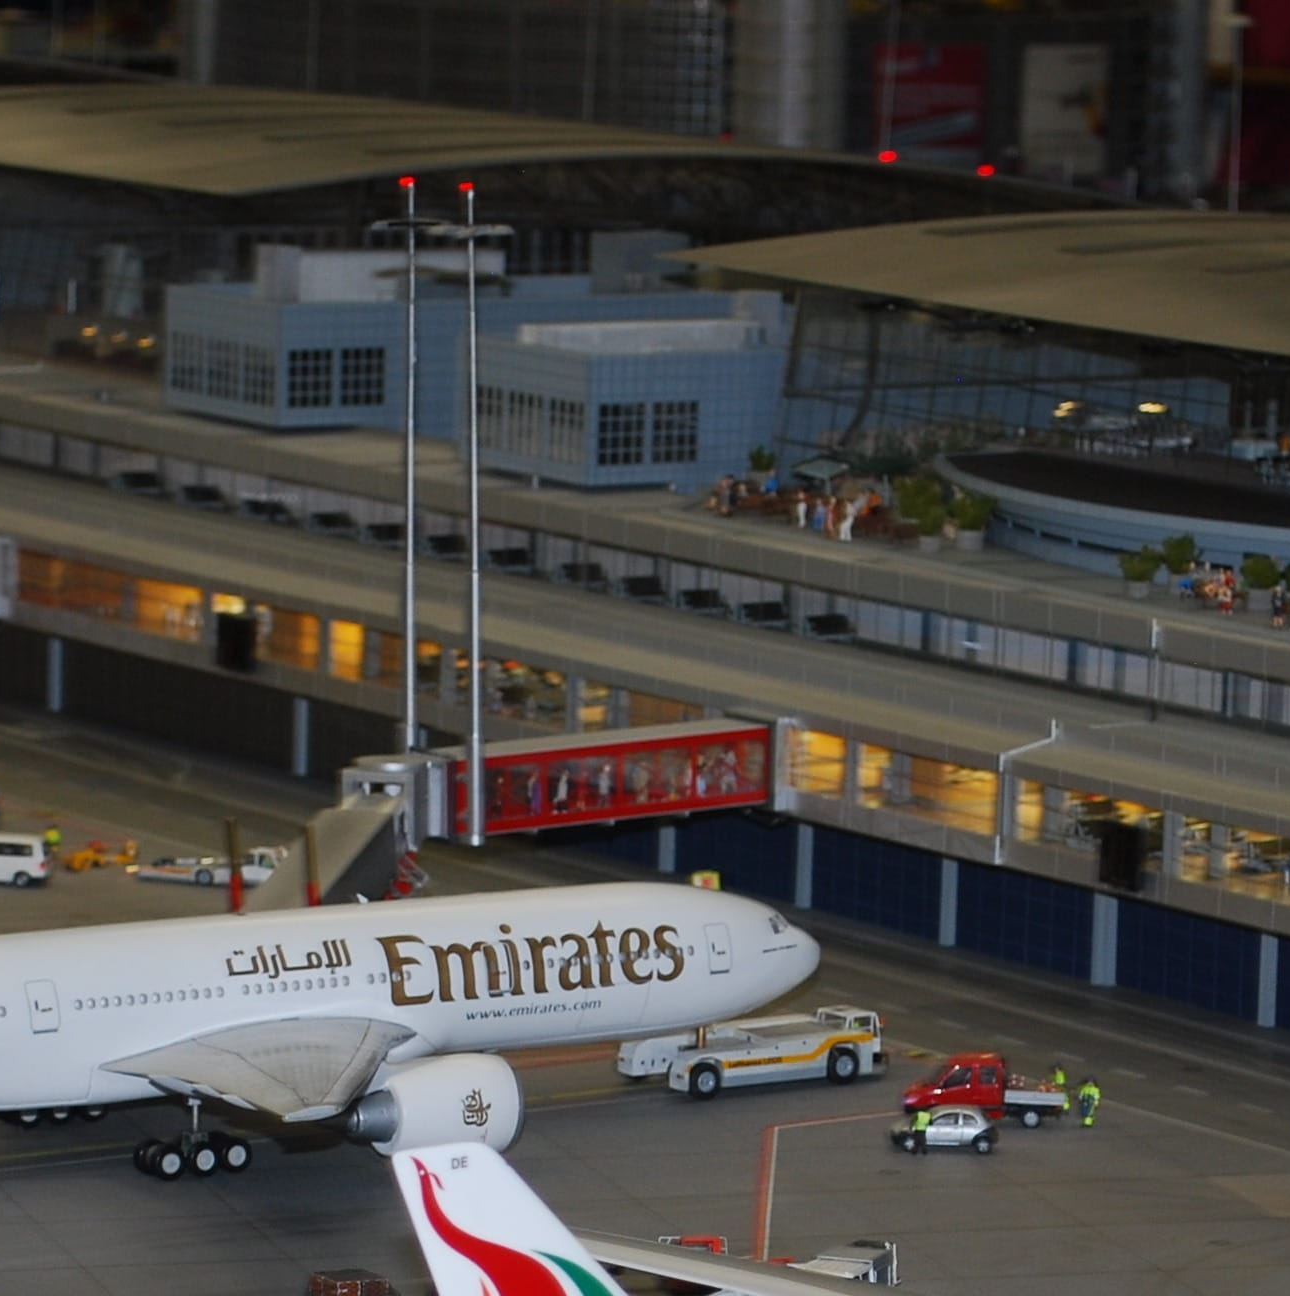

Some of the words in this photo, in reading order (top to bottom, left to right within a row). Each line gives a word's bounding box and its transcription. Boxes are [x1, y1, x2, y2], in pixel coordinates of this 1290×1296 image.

[225, 939, 352, 979] الإمارات
[374, 920, 685, 1007] Emirates
[465, 999, 603, 1021] www.emirates.com
[451, 1155, 469, 1170] DE
